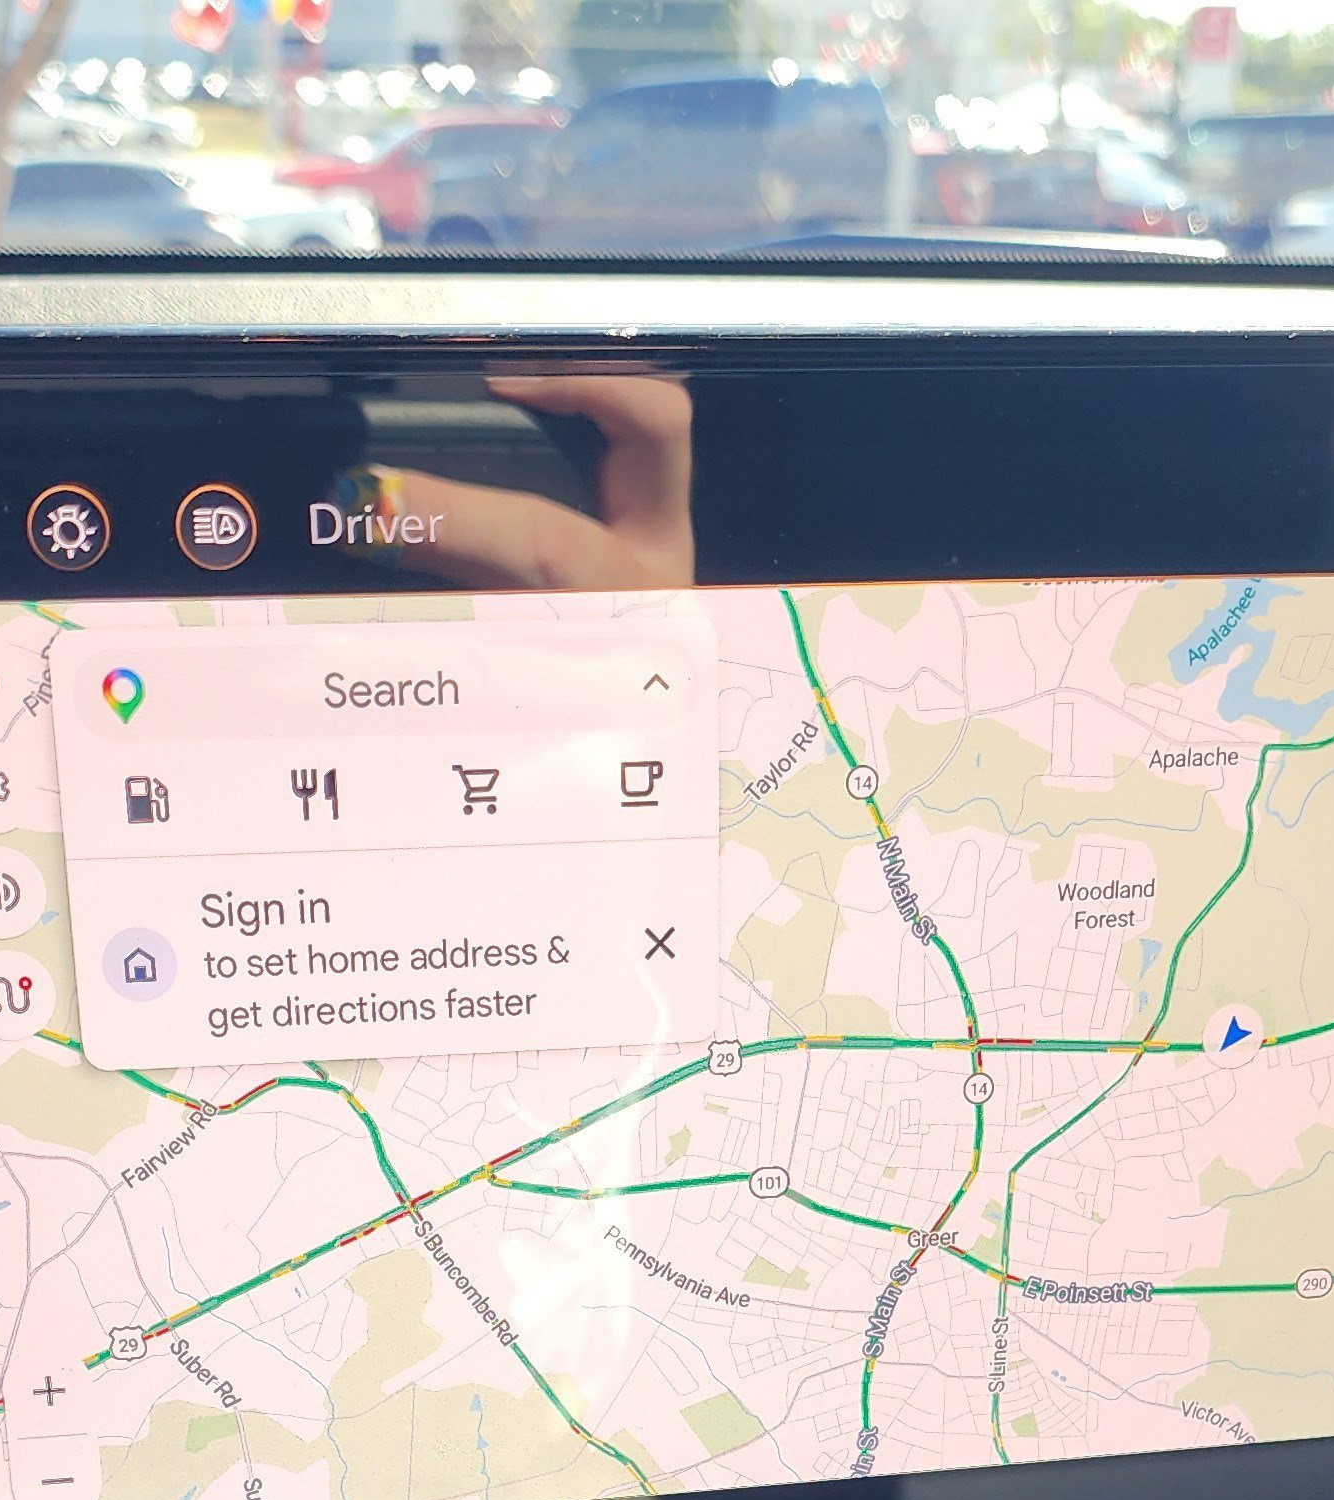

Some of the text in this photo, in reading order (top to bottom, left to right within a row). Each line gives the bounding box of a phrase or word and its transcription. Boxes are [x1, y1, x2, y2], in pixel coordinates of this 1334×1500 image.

[308, 501, 444, 546] Driver
[1187, 586, 1256, 667] Apalachee
[323, 671, 460, 709] Search
[743, 720, 819, 800] Taylor Rd
[1148, 746, 1239, 769] Apalache
[854, 775, 872, 792] 14
[876, 836, 937, 946] N Main St
[1057, 878, 1155, 901] Woodland
[200, 889, 331, 937] Sign in
[1074, 908, 1135, 929] Forest
[204, 937, 570, 981] to set home address &
[208, 988, 536, 1040] get directions faster
[717, 1052, 734, 1069] 29
[970, 1081, 988, 1097] 14
[121, 1098, 218, 1188] Fairview Rd
[757, 1173, 782, 1191] 101
[907, 1229, 959, 1249] Greer
[415, 1219, 519, 1347] S Buncombe Rd
[603, 1225, 751, 1309] Pennsylvania Ave
[1301, 1276, 1328, 1292] 290
[1023, 1276, 1152, 1303] E Poinsett St
[862, 1259, 917, 1359] S Main St
[118, 1337, 139, 1353] 29
[988, 1316, 1008, 1393] S Line St
[170, 1338, 242, 1409] Suber Rd
[1181, 1400, 1230, 1428] Victor
[857, 1426, 878, 1451] St
